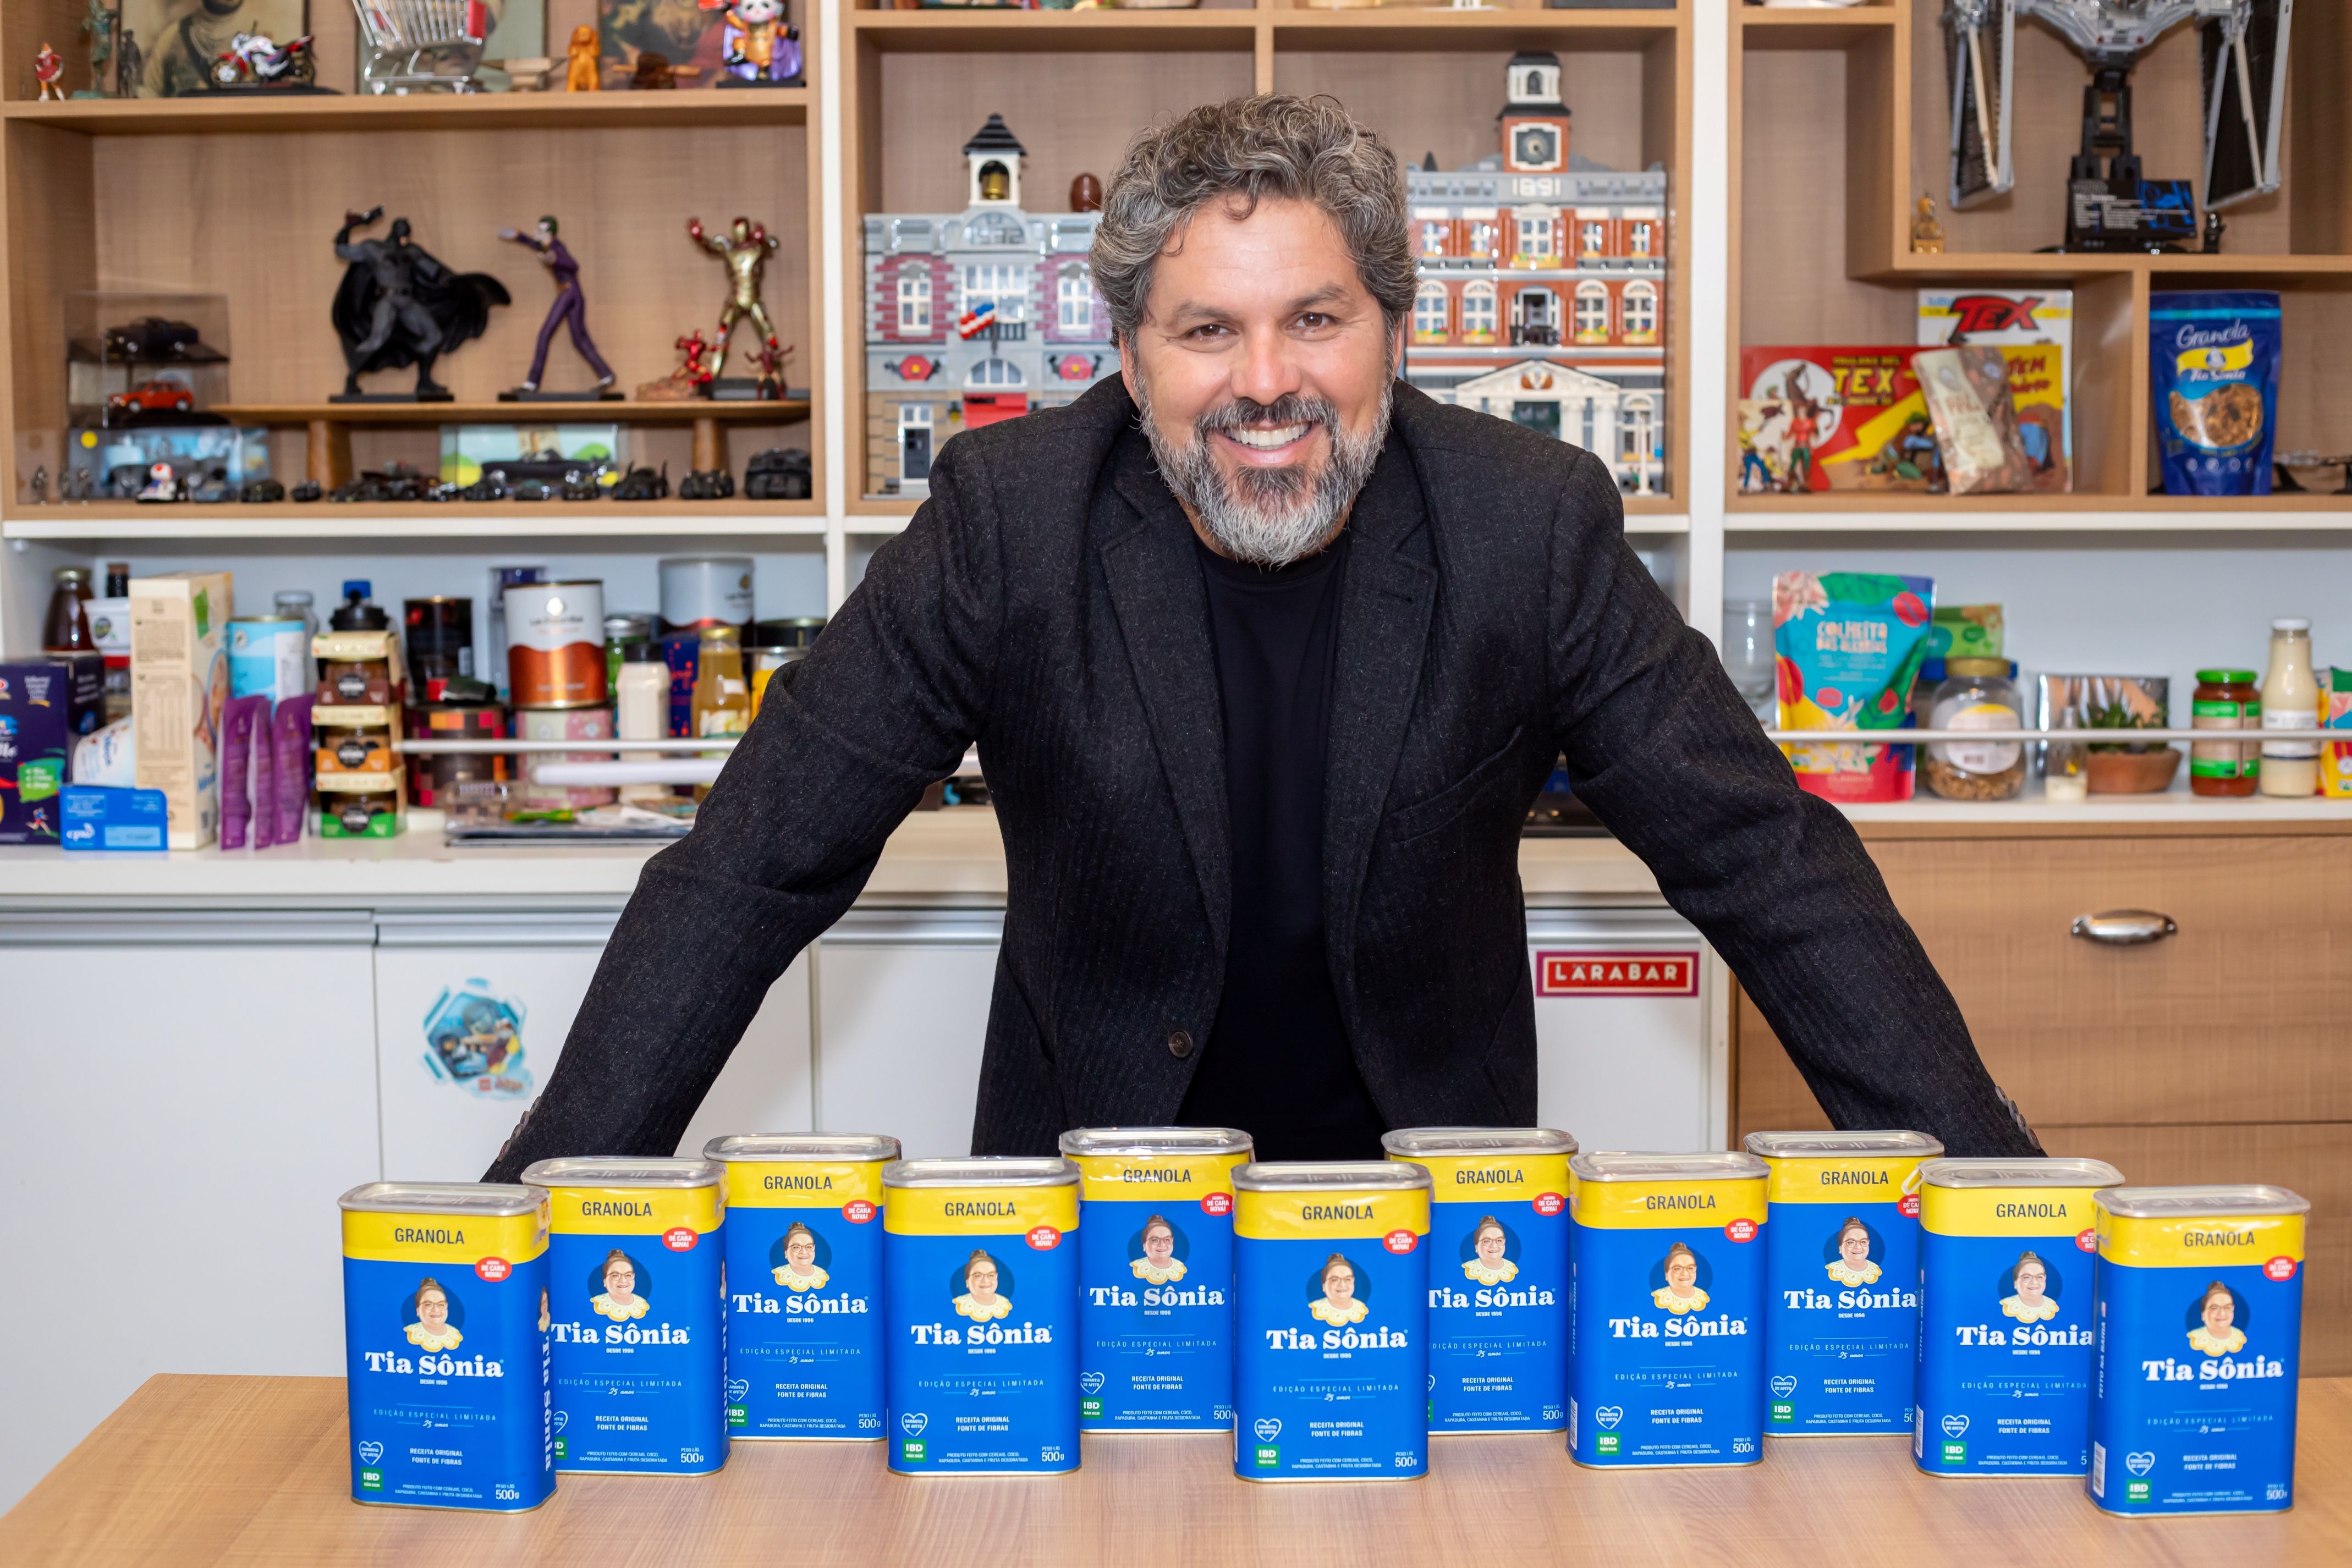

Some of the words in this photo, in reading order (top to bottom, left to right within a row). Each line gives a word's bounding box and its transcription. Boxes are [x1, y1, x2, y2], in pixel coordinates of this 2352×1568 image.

[1512, 177, 1561, 196] 1891
[1949, 295, 2044, 333] TEX
[2176, 318, 2251, 349] Granola
[1832, 367, 1894, 394] TEX
[765, 1176, 832, 1189] GRANOLA
[1124, 1169, 1191, 1182] GRANOLA
[1457, 1170, 1524, 1184] GRANOLA
[1822, 1171, 1888, 1185] GRANOLA
[582, 1202, 651, 1216] GRANOLA
[945, 1202, 1015, 1216] GRANOLA
[1647, 1195, 1716, 1209] GRANOLA
[1997, 1204, 2067, 1217] GRANOLA
[1303, 1206, 1373, 1220] GRANOLA
[395, 1228, 464, 1244] GRANOLA
[2185, 1231, 2255, 1247] GRANOLA
[733, 1292, 781, 1313] Tia
[787, 1293, 868, 1313] Sônia
[1090, 1286, 1137, 1306] Tia
[1144, 1284, 1224, 1306] Sônia
[1475, 1284, 1555, 1307] Sônia
[1784, 1289, 1832, 1309] Tia
[1838, 1287, 1917, 1308] Sônia
[551, 1321, 600, 1344] Tia
[606, 1323, 690, 1344] Sônia
[911, 1323, 961, 1345] Tia
[968, 1322, 1052, 1345] Sônia
[1609, 1316, 1659, 1338] Tia
[1665, 1313, 1747, 1337] Sônia
[1957, 1324, 2007, 1345] Tia
[2013, 1324, 2092, 1345] Sônia
[1266, 1328, 1317, 1349] Tia
[1323, 1325, 1408, 1349] Sônia
[365, 1351, 413, 1374] Tia
[419, 1352, 504, 1377] Sônia
[2100, 1355, 2104, 1369] NA
[2142, 1358, 2194, 1380] Tia
[2200, 1355, 2283, 1380] Sônia
[409, 1412, 447, 1421] ESPECIAL
